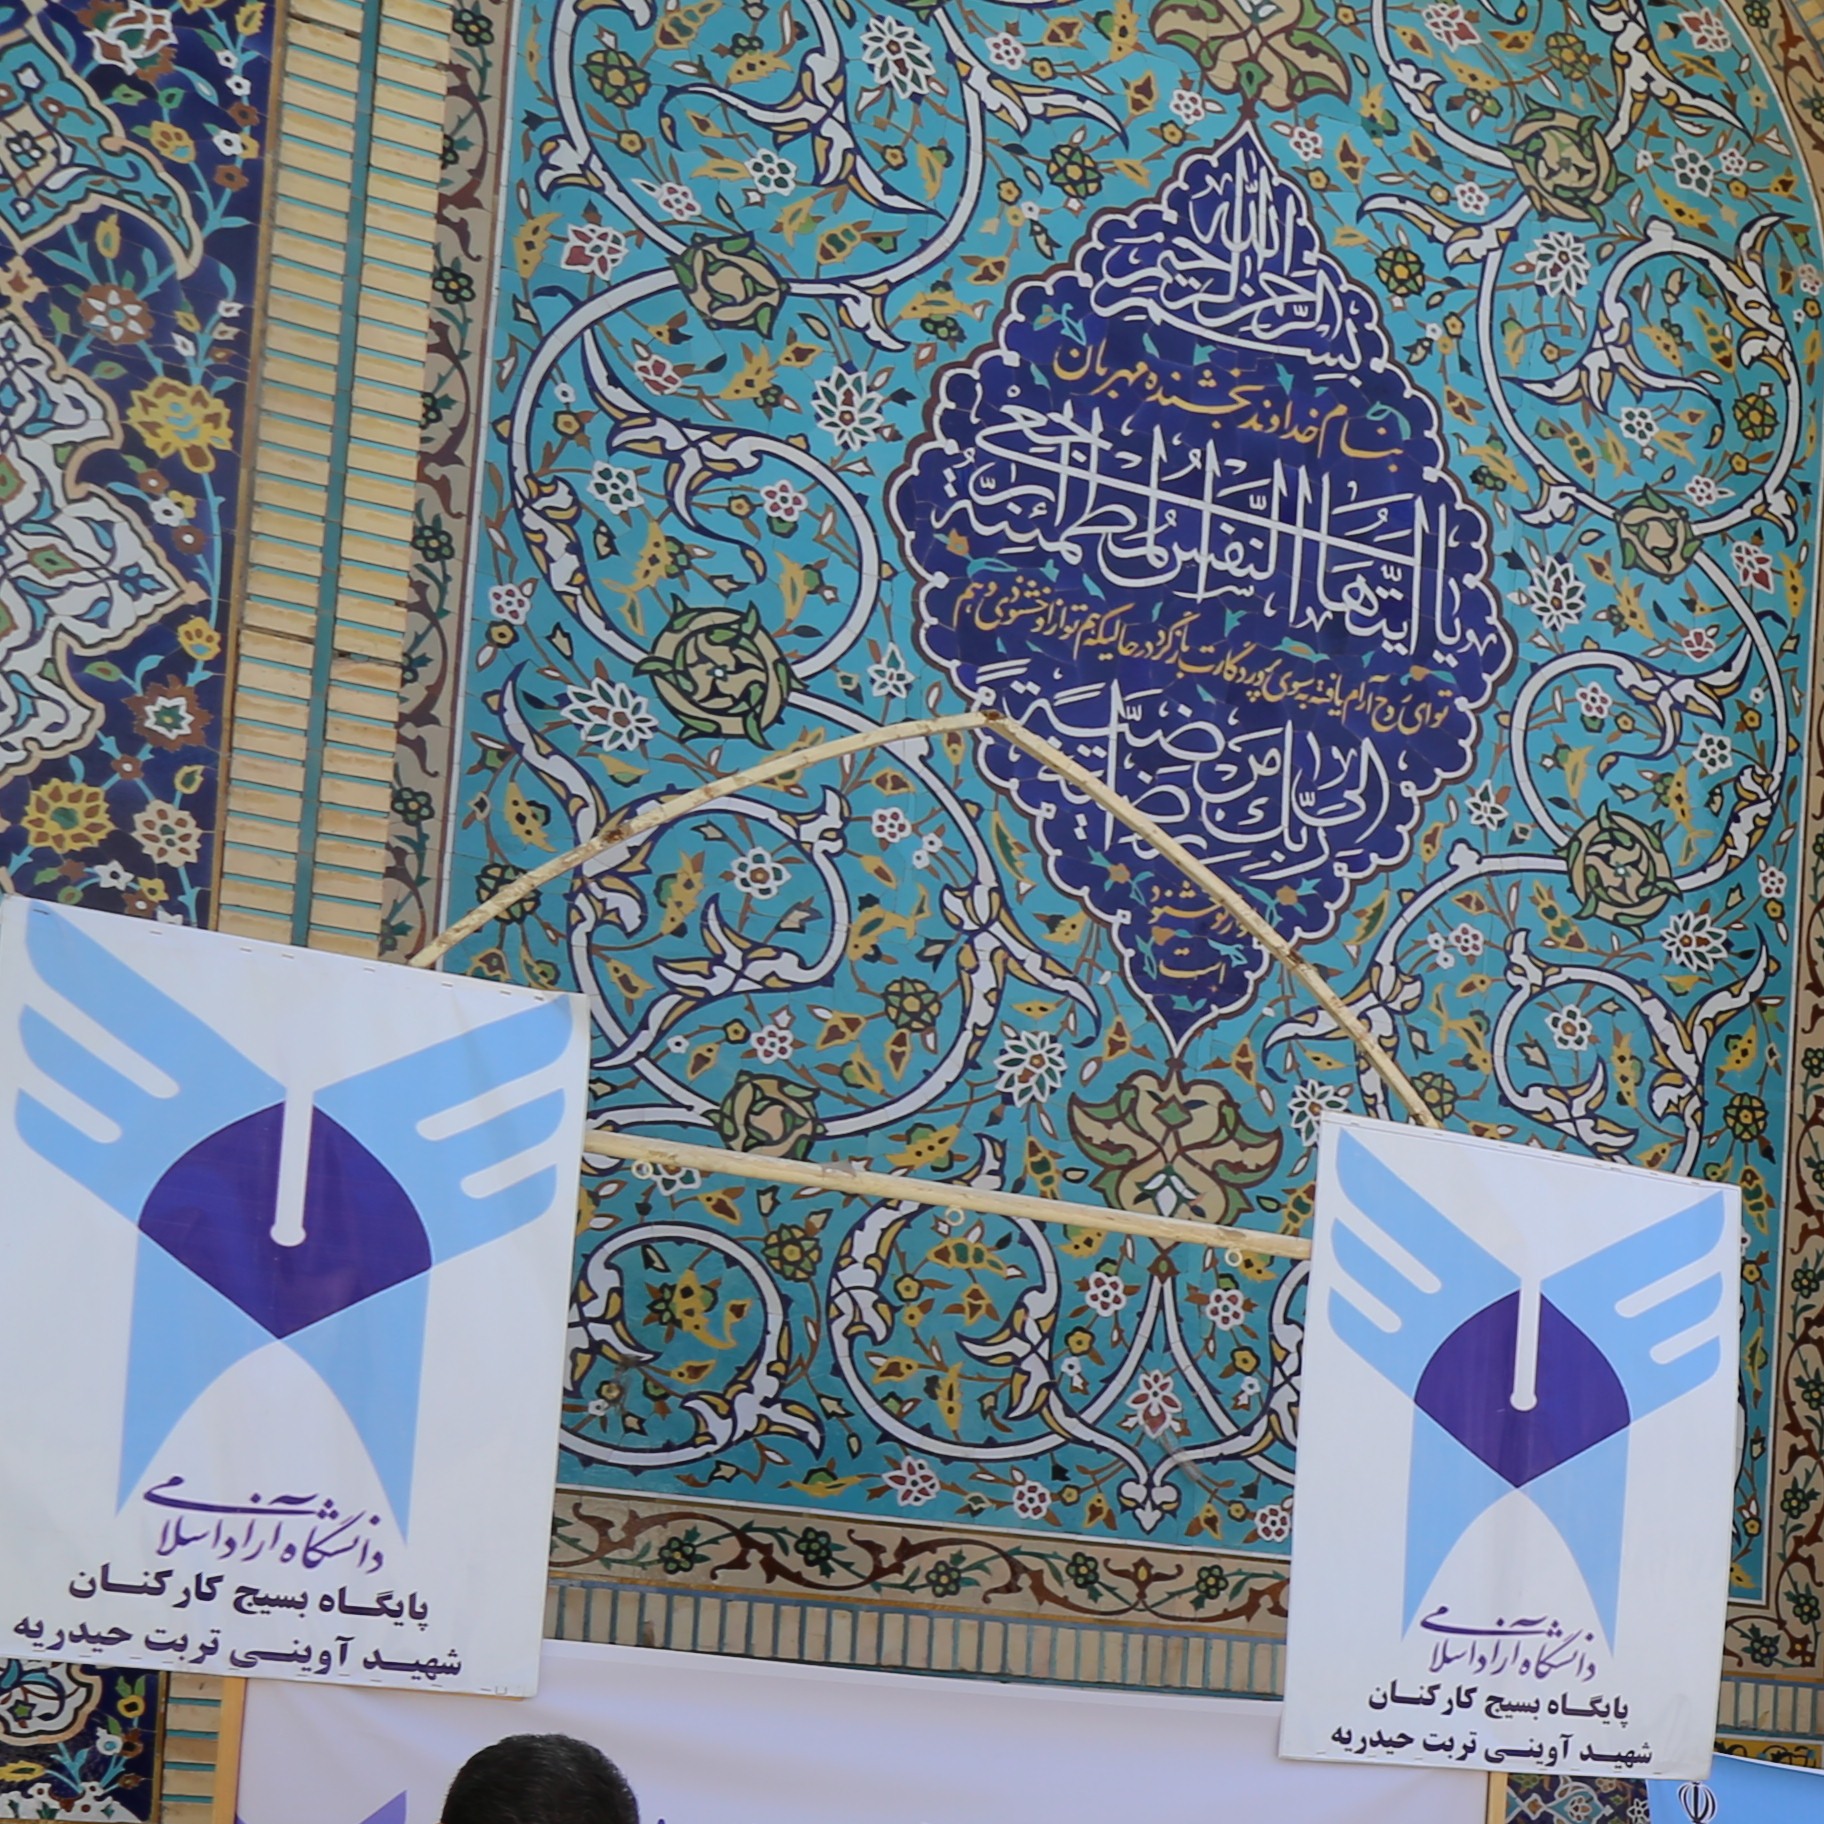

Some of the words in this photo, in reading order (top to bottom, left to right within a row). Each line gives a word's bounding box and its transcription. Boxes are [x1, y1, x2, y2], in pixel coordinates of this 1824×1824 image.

[68, 1563, 223, 1608] کارکنان
[232, 1583, 307, 1619] بسیج
[318, 1586, 428, 1631] پایگاه
[12, 1614, 132, 1654] حیدریه
[143, 1626, 220, 1666] تربت
[230, 1635, 355, 1676] آوینی
[362, 1645, 462, 1678] شهید
[1368, 1679, 1477, 1717] کارکنان
[1484, 1692, 1540, 1720] بسیج
[1547, 1694, 1628, 1728] پایگاه
[1331, 1725, 1414, 1755] حیدریه
[1422, 1731, 1477, 1763] تربت
[1484, 1733, 1571, 1767] آوینی
[1579, 1742, 1652, 1770] شهید
